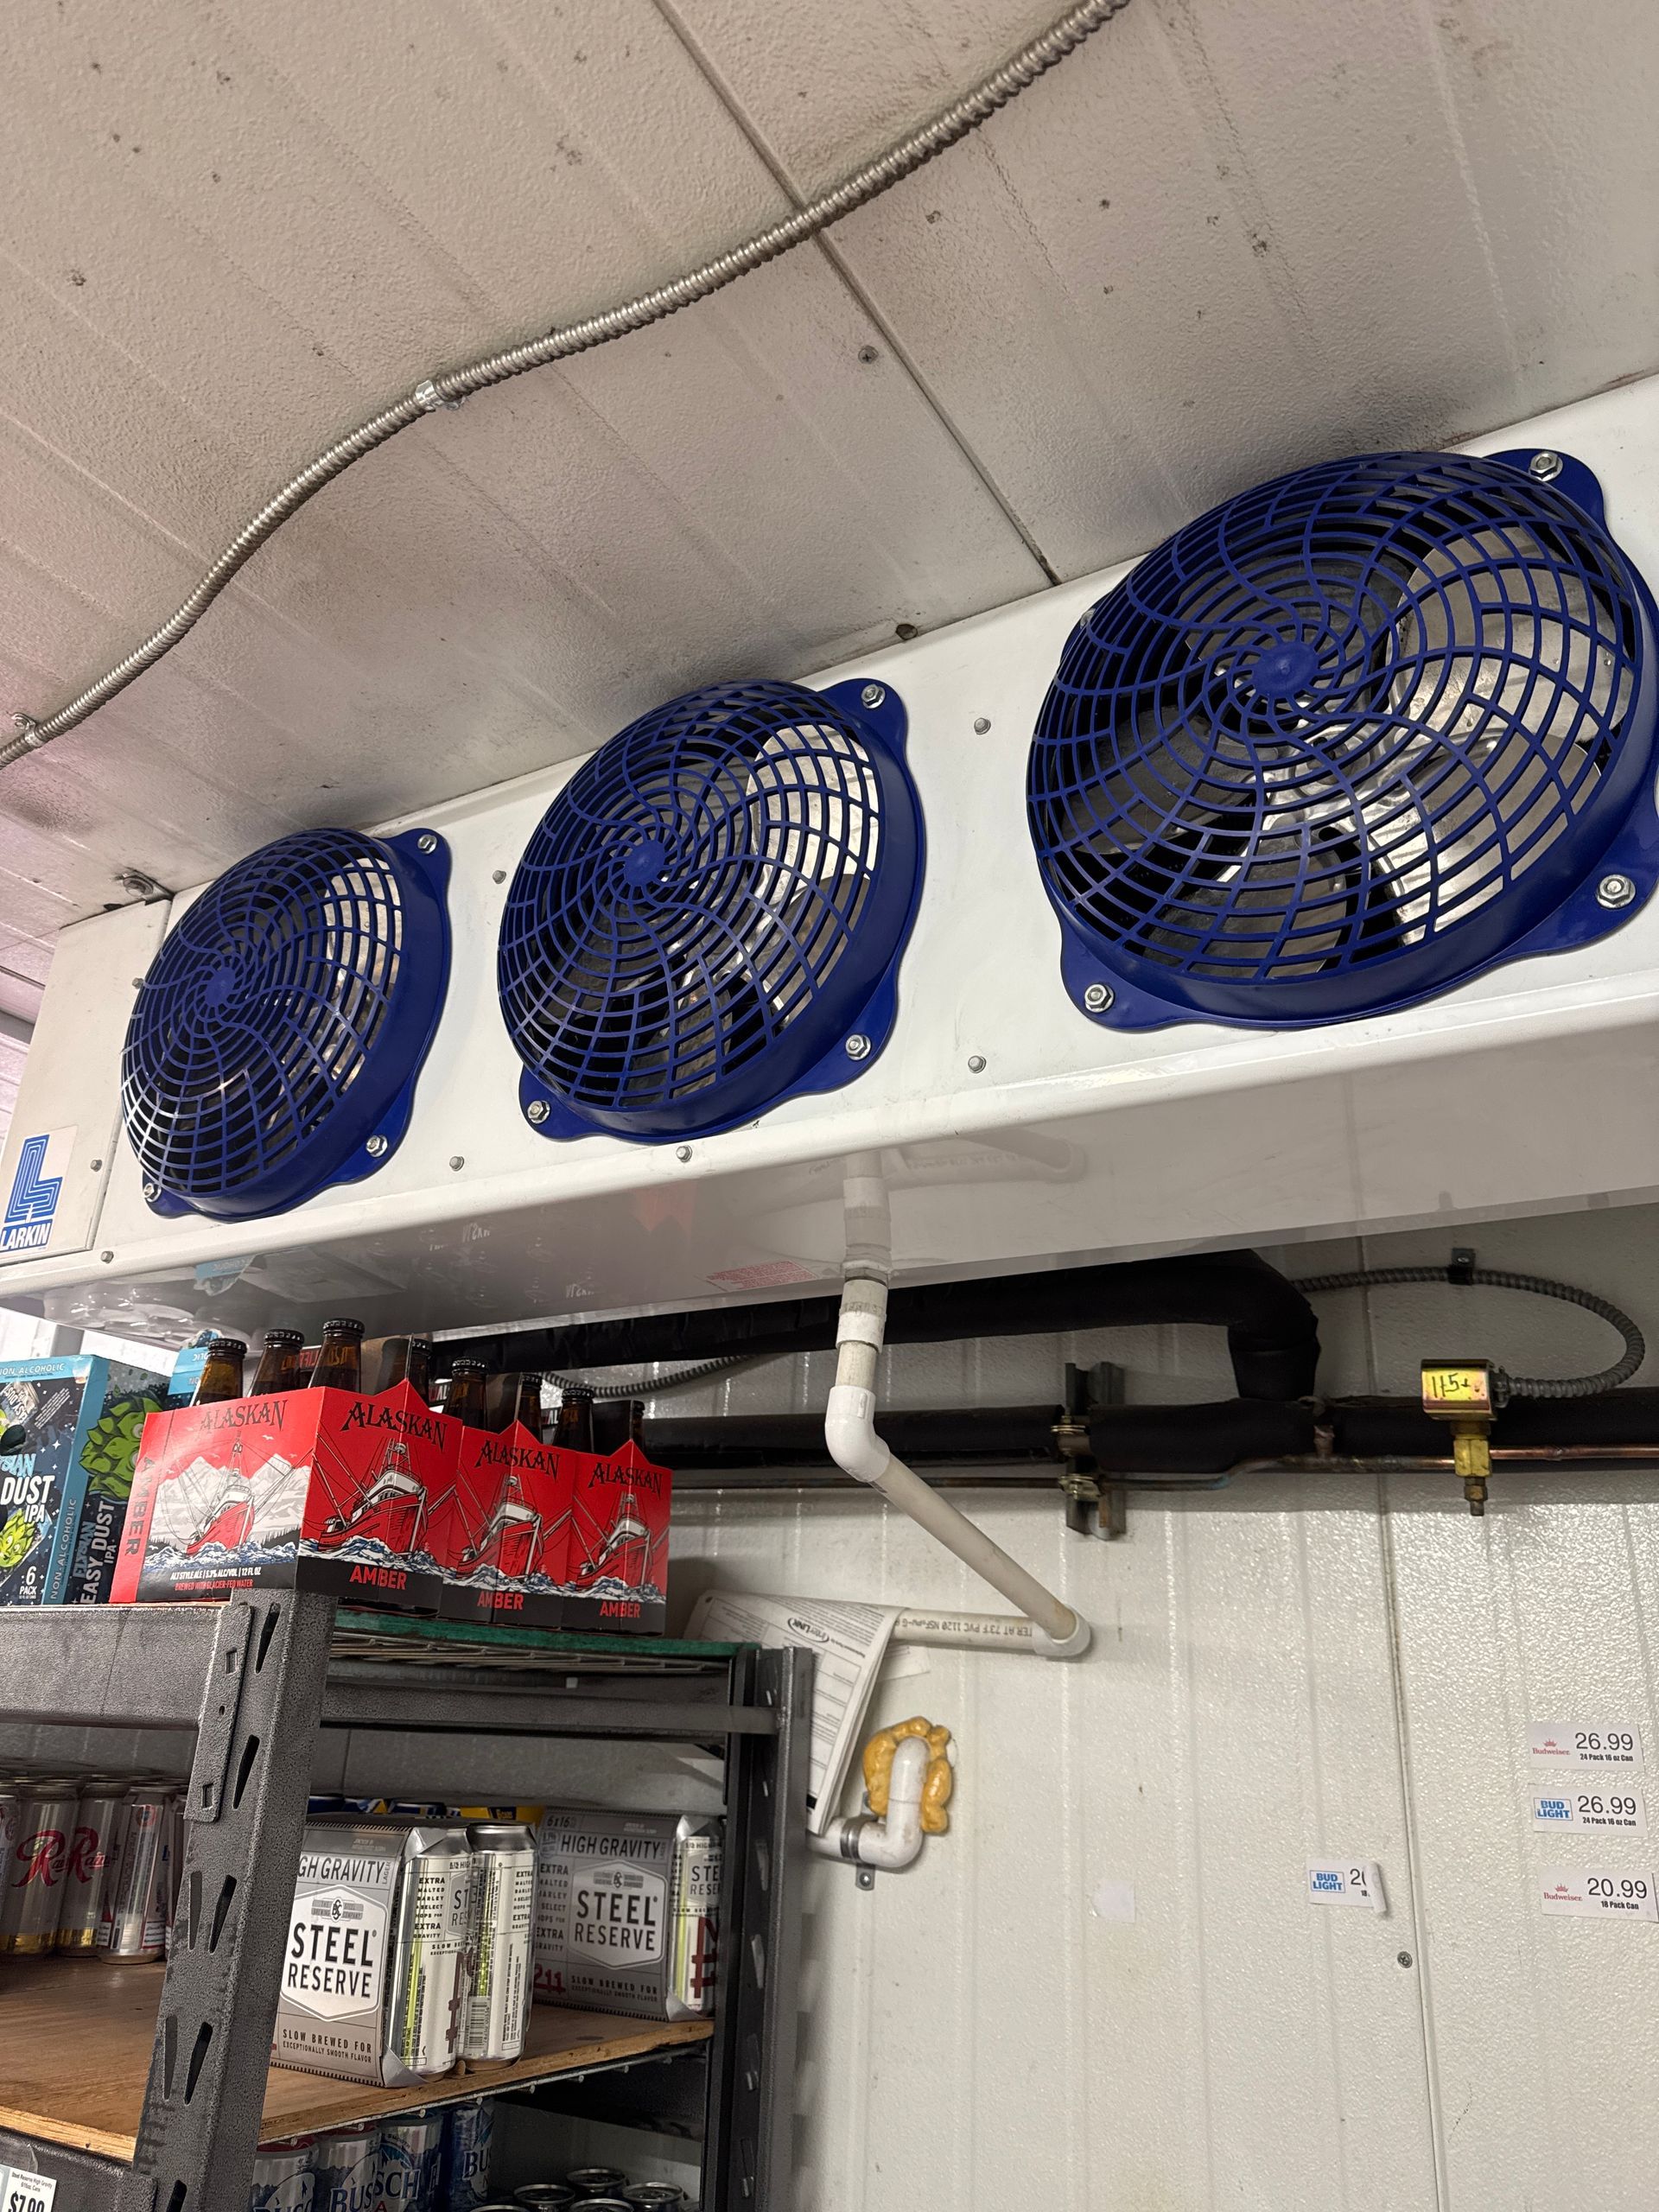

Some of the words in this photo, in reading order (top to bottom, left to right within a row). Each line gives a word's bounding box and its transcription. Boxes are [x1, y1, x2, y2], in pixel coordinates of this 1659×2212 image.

[0, 1222, 52, 1250] LARKIN
[200, 1400, 288, 1432] ALASKAN
[340, 1401, 448, 1453] ALASKAN
[475, 1439, 561, 1483] ALASKAN
[1, 1476, 55, 1505] DUST
[588, 1462, 663, 1500] ALASKAN
[24, 1504, 46, 1523] IPA
[124, 1456, 156, 1555] AMBER
[91, 1501, 115, 1552] DUST
[104, 1544, 117, 1564] IPA
[26, 1566, 36, 1586] 6
[79, 1556, 104, 1605] EASY
[349, 1565, 407, 1590] AMBER
[19, 1586, 37, 1595] PACK
[477, 1591, 524, 1611] AMBER
[600, 1599, 641, 1618] AMBER
[941, 1621, 961, 1631] 1120
[963, 1623, 980, 1633] PVC
[1575, 1732, 1634, 1751] 26.99
[1538, 1808, 1570, 1818] LIGHT
[1541, 1800, 1565, 1809] BUD
[1577, 1795, 1637, 1815] 26.99
[562, 1834, 597, 1855] HIGH
[599, 1837, 660, 1860] GRAVITY
[297, 1855, 319, 1878] GH
[321, 1857, 385, 1884] GRAVITY
[382, 1861, 391, 1885] LAGER
[540, 1863, 569, 1876] EXTRA
[691, 1866, 719, 1882] STE
[1316, 1872, 1338, 1882] BUD
[1313, 1881, 1343, 1891] LIGHT
[1586, 1877, 1647, 1899] 20.99
[541, 1903, 567, 1912] SELECT
[576, 1890, 656, 1927] STEEL
[537, 1926, 564, 1940] EXTRA
[575, 1922, 656, 1951] RESERVE
[291, 1922, 373, 1967] STEEL
[288, 1962, 372, 1999] RESERVE
[534, 1962, 566, 1991] 211
[571, 1975, 594, 1986] SLOW
[600, 1979, 635, 1992] BREWED
[640, 1984, 657, 1994] FOR
[283, 2029, 306, 2042] SLOW
[312, 2033, 348, 2049] BREWED
[354, 2041, 372, 2054] FOR
[283, 2041, 325, 2055] EXCEPTIONALLY
[327, 2049, 349, 2059] SMOOTH
[351, 2052, 372, 2063] FLAVOR
